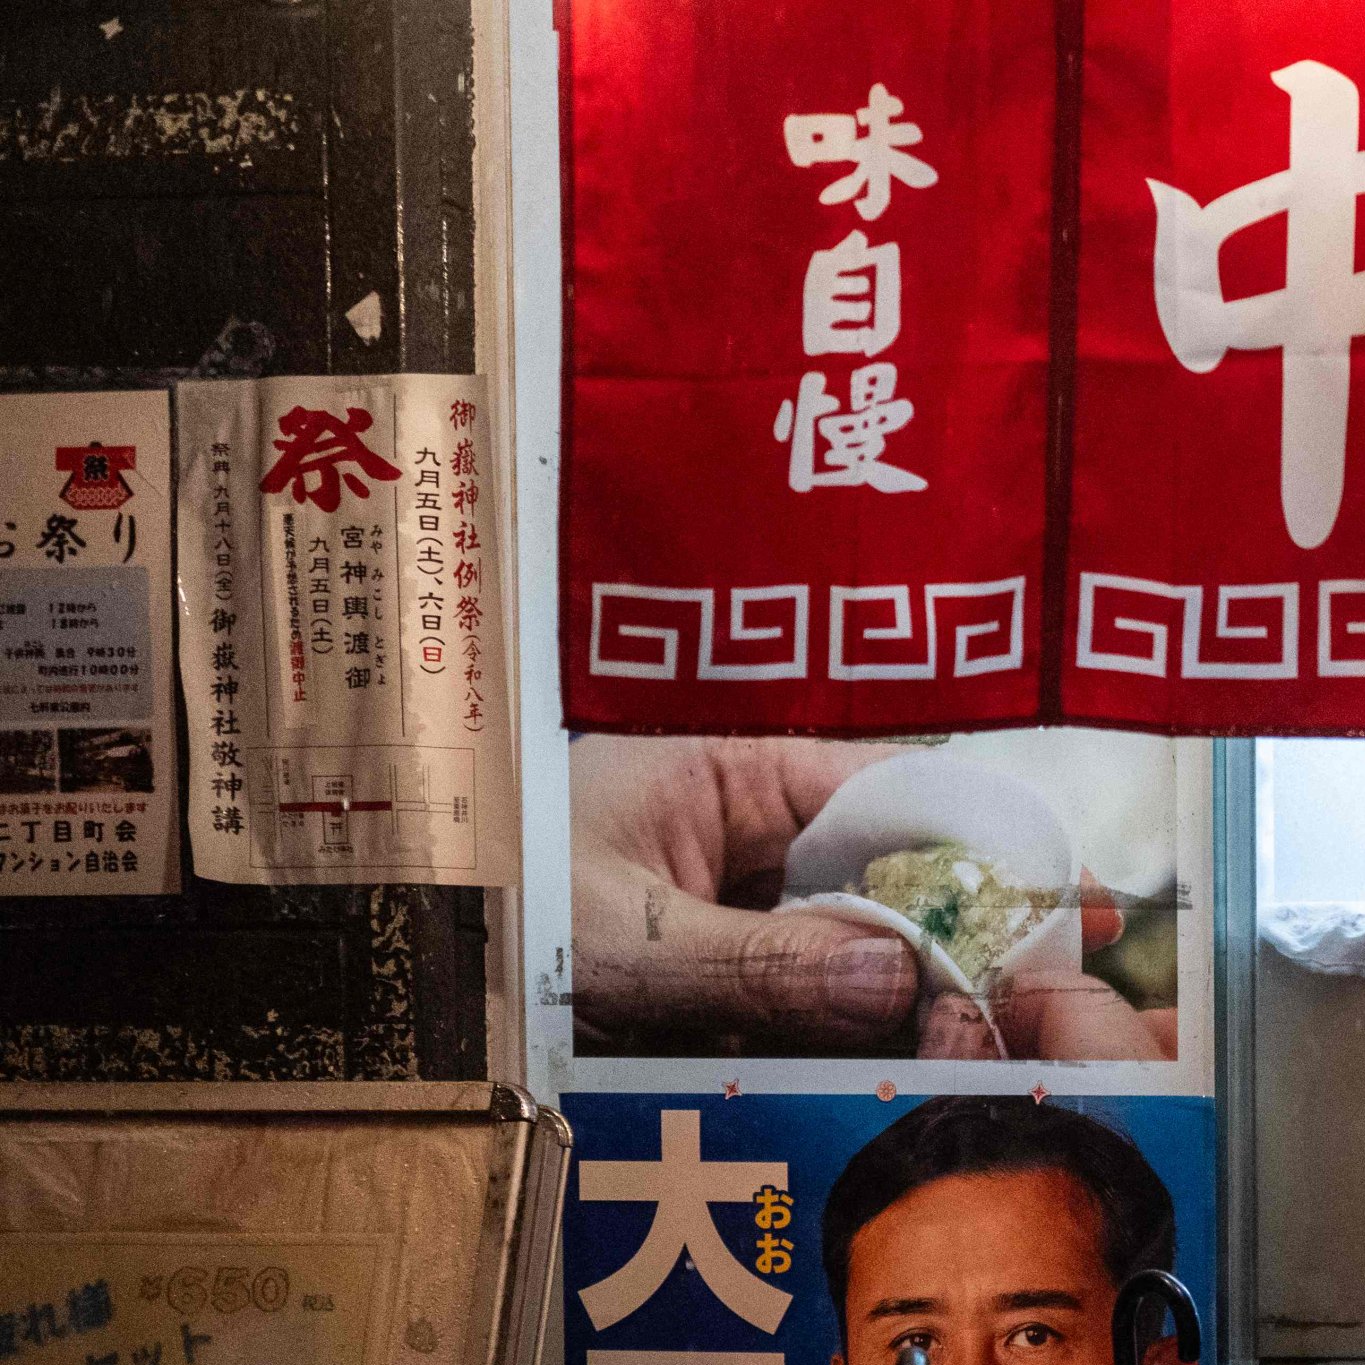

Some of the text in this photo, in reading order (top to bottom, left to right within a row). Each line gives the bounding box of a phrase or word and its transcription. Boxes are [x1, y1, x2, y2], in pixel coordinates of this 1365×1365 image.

[773, 82, 938, 494] 味自慢
[259, 404, 404, 513] 祭
[340, 525, 372, 690] 宮神輿渡御
[754, 1184, 795, 1275] おお
